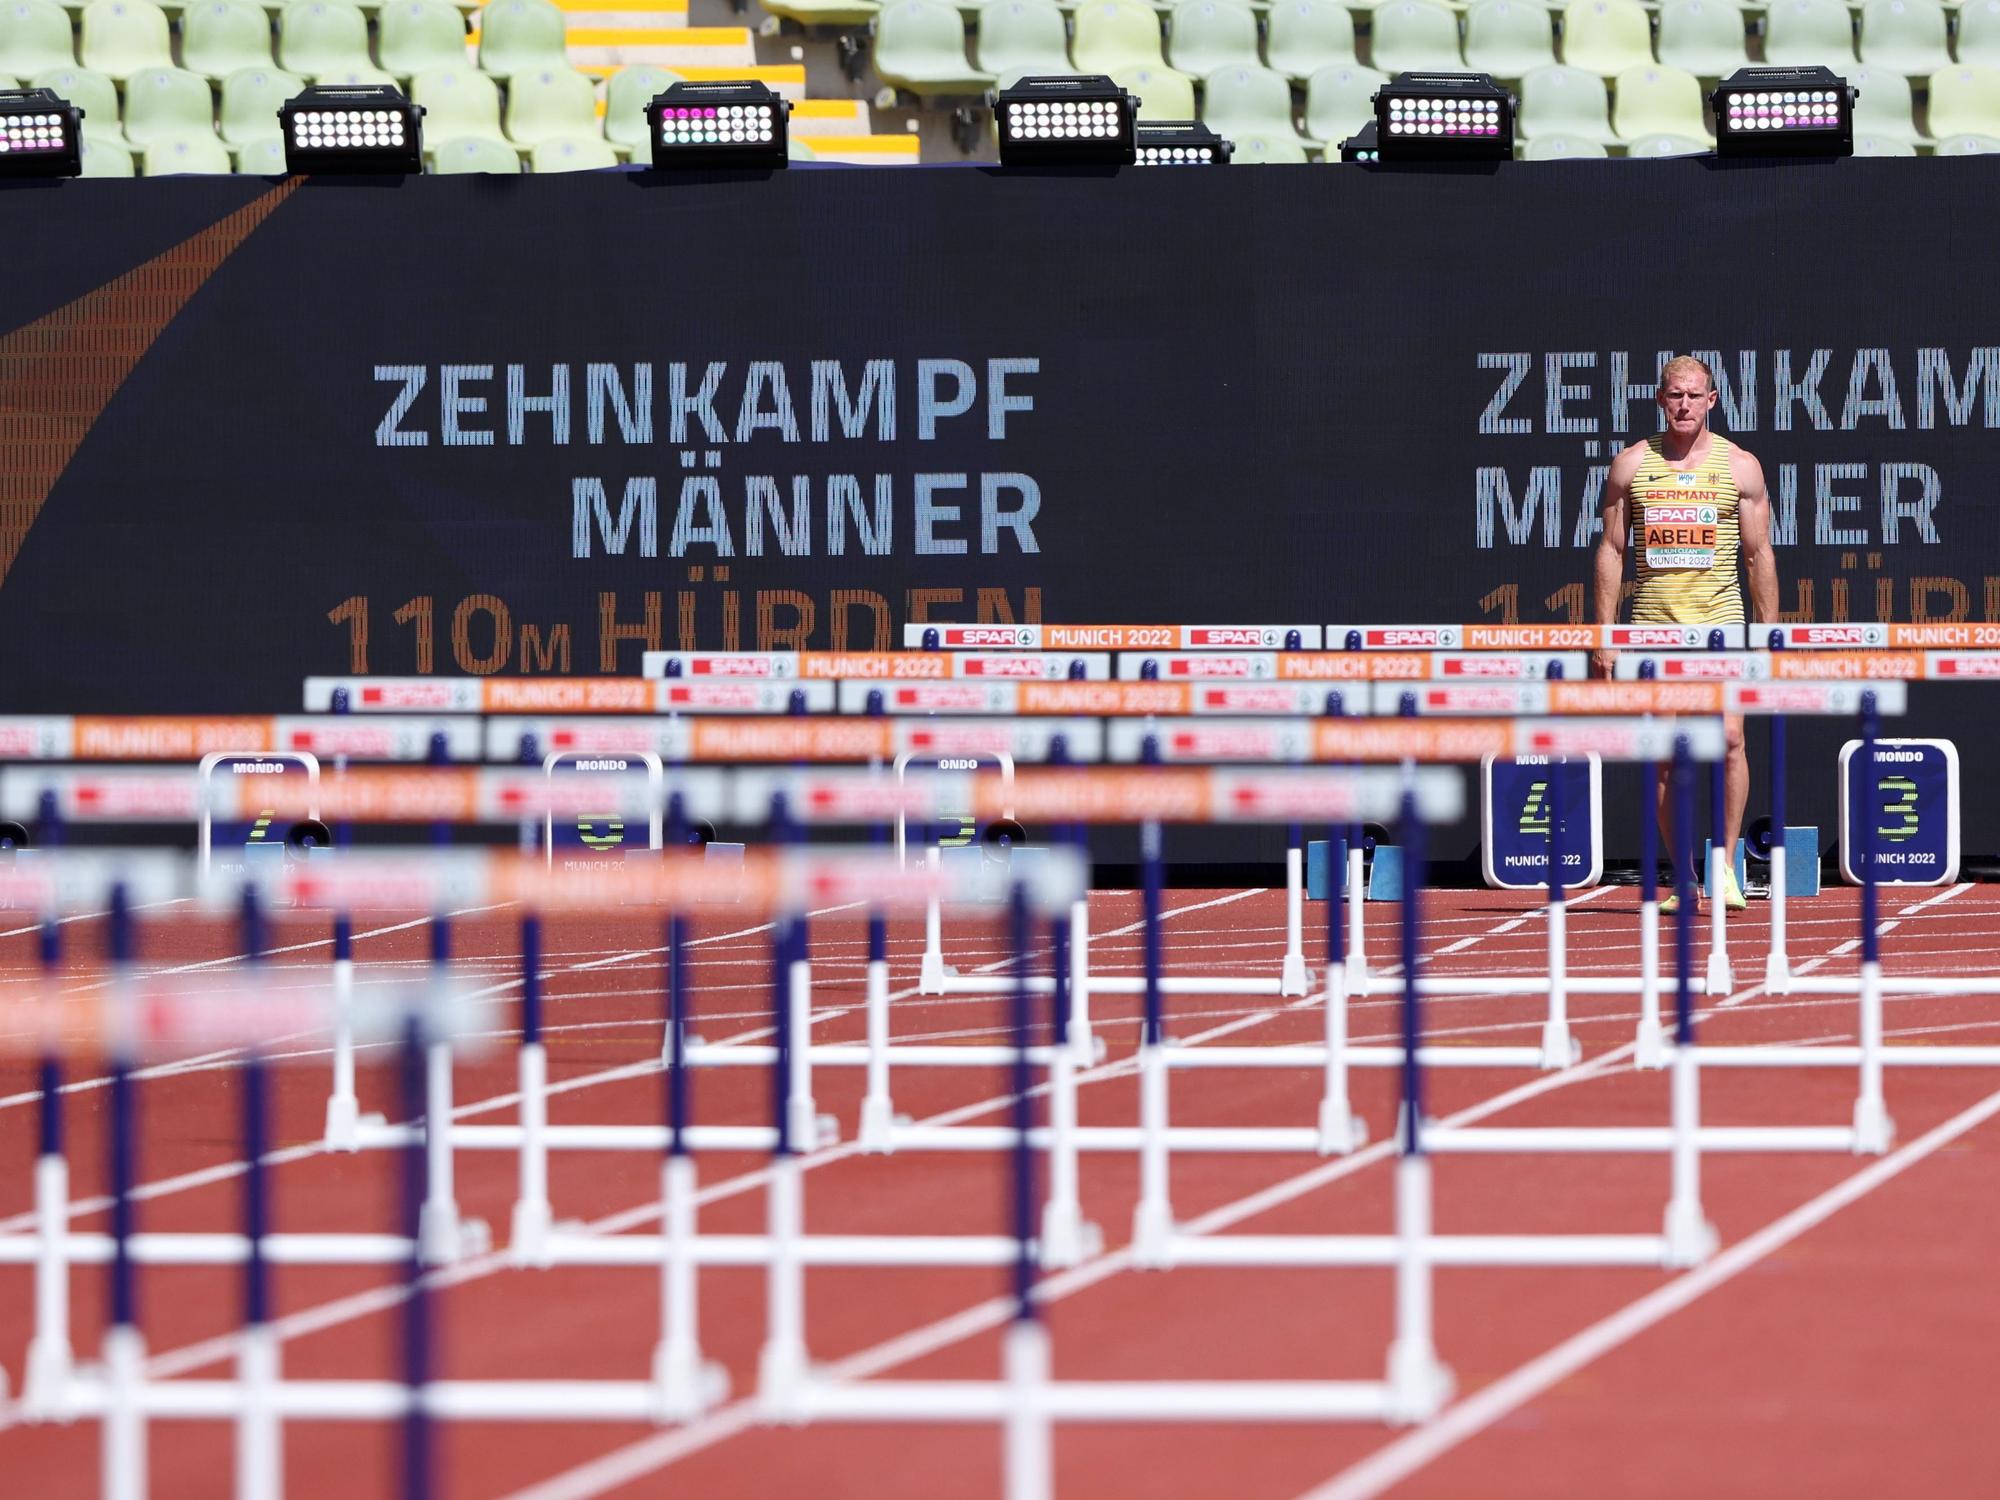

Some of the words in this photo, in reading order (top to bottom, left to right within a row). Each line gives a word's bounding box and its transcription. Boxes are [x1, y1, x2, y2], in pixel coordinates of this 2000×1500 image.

[373, 357, 1041, 447] ZEHNKAMPF
[1645, 490, 1719, 501] GERMANY
[572, 450, 1042, 558] MÄNNER
[1647, 509, 1697, 521] SPAR
[1647, 529, 1714, 545] ABELE
[1650, 556, 1686, 565] MUNICH
[1688, 556, 1711, 566] 2022
[962, 630, 1015, 645] SPAR
[1051, 629, 1122, 646] MUNICH
[1128, 629, 1172, 646] 2022
[1207, 630, 1261, 645] SPAR
[1383, 630, 1437, 645] SPAR
[1472, 629, 1543, 646] MUNICH
[1549, 629, 1593, 646] 2022
[1628, 630, 1682, 645] SPAR
[1807, 629, 1862, 643] SPAR
[1896, 627, 1968, 644] MUNICH
[807, 656, 887, 677] MUNICH
[894, 656, 944, 677] 2022
[1285, 656, 1368, 677] MUNICH
[1372, 656, 1422, 678] 2022
[1780, 658, 1860, 678] MUNICH
[1873, 751, 1924, 762] MONDO
[233, 763, 284, 774] MONDO
[575, 760, 628, 771] MONDO
[937, 759, 978, 769] ONDO
[1878, 775, 1919, 841] 3
[1505, 855, 1549, 867] MUNICH
[1908, 853, 1936, 864] 2022
[564, 861, 608, 872] MUNICH
